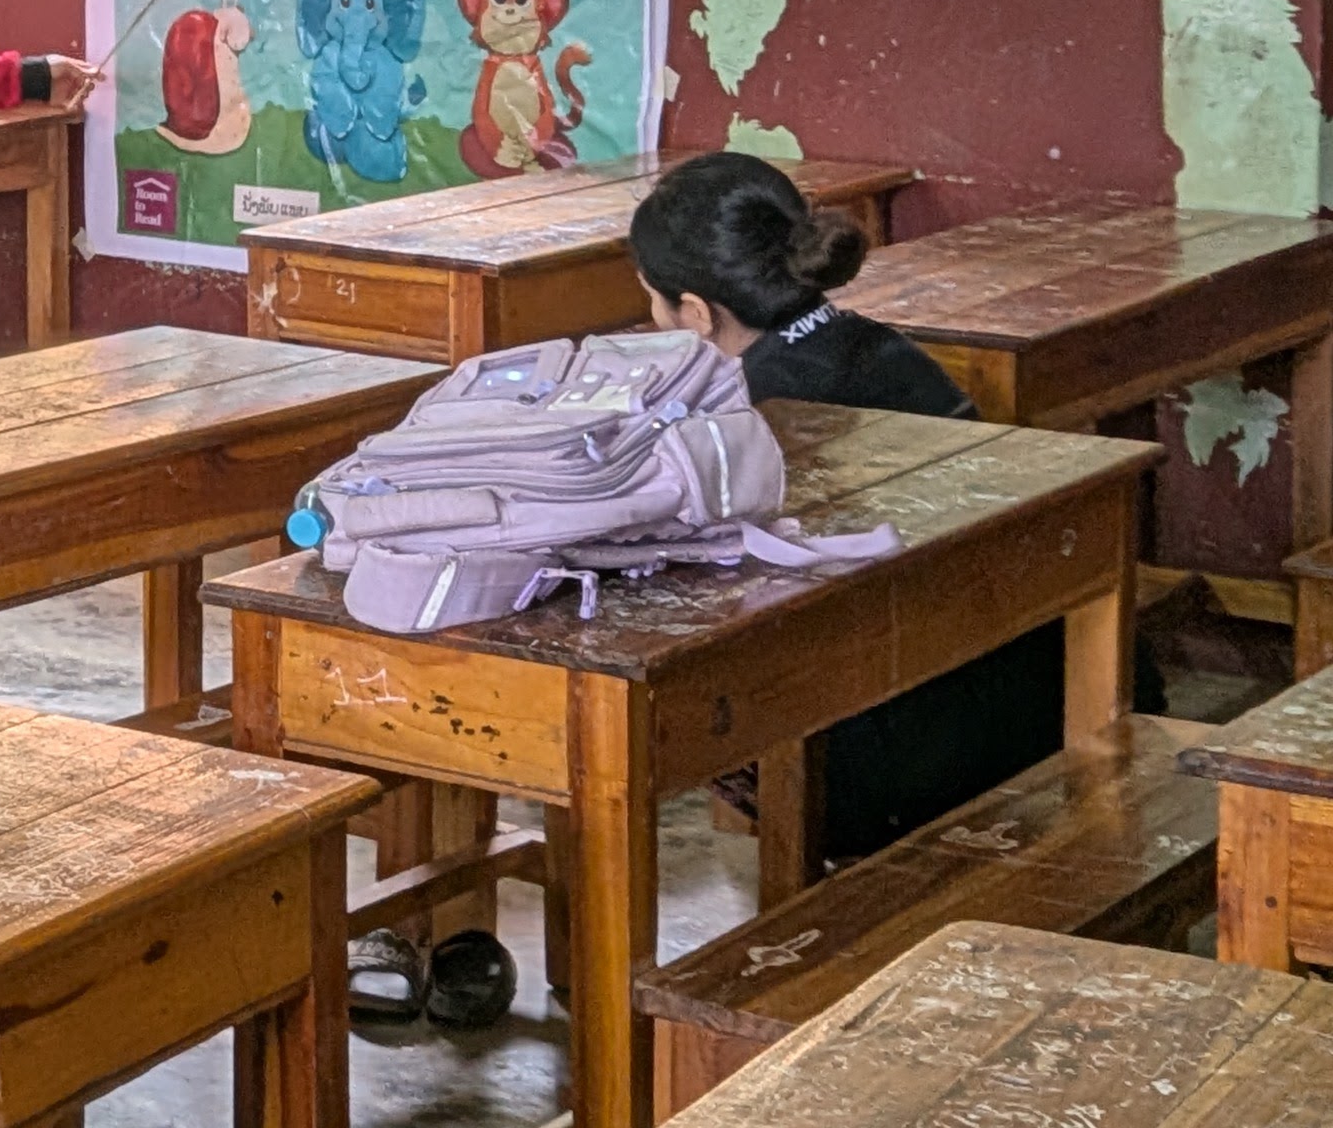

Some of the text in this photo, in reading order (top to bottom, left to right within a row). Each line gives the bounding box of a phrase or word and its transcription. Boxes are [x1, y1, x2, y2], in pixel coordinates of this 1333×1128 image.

[136, 187, 168, 202] Room
[135, 201, 146, 212] to
[134, 213, 162, 227] Read
